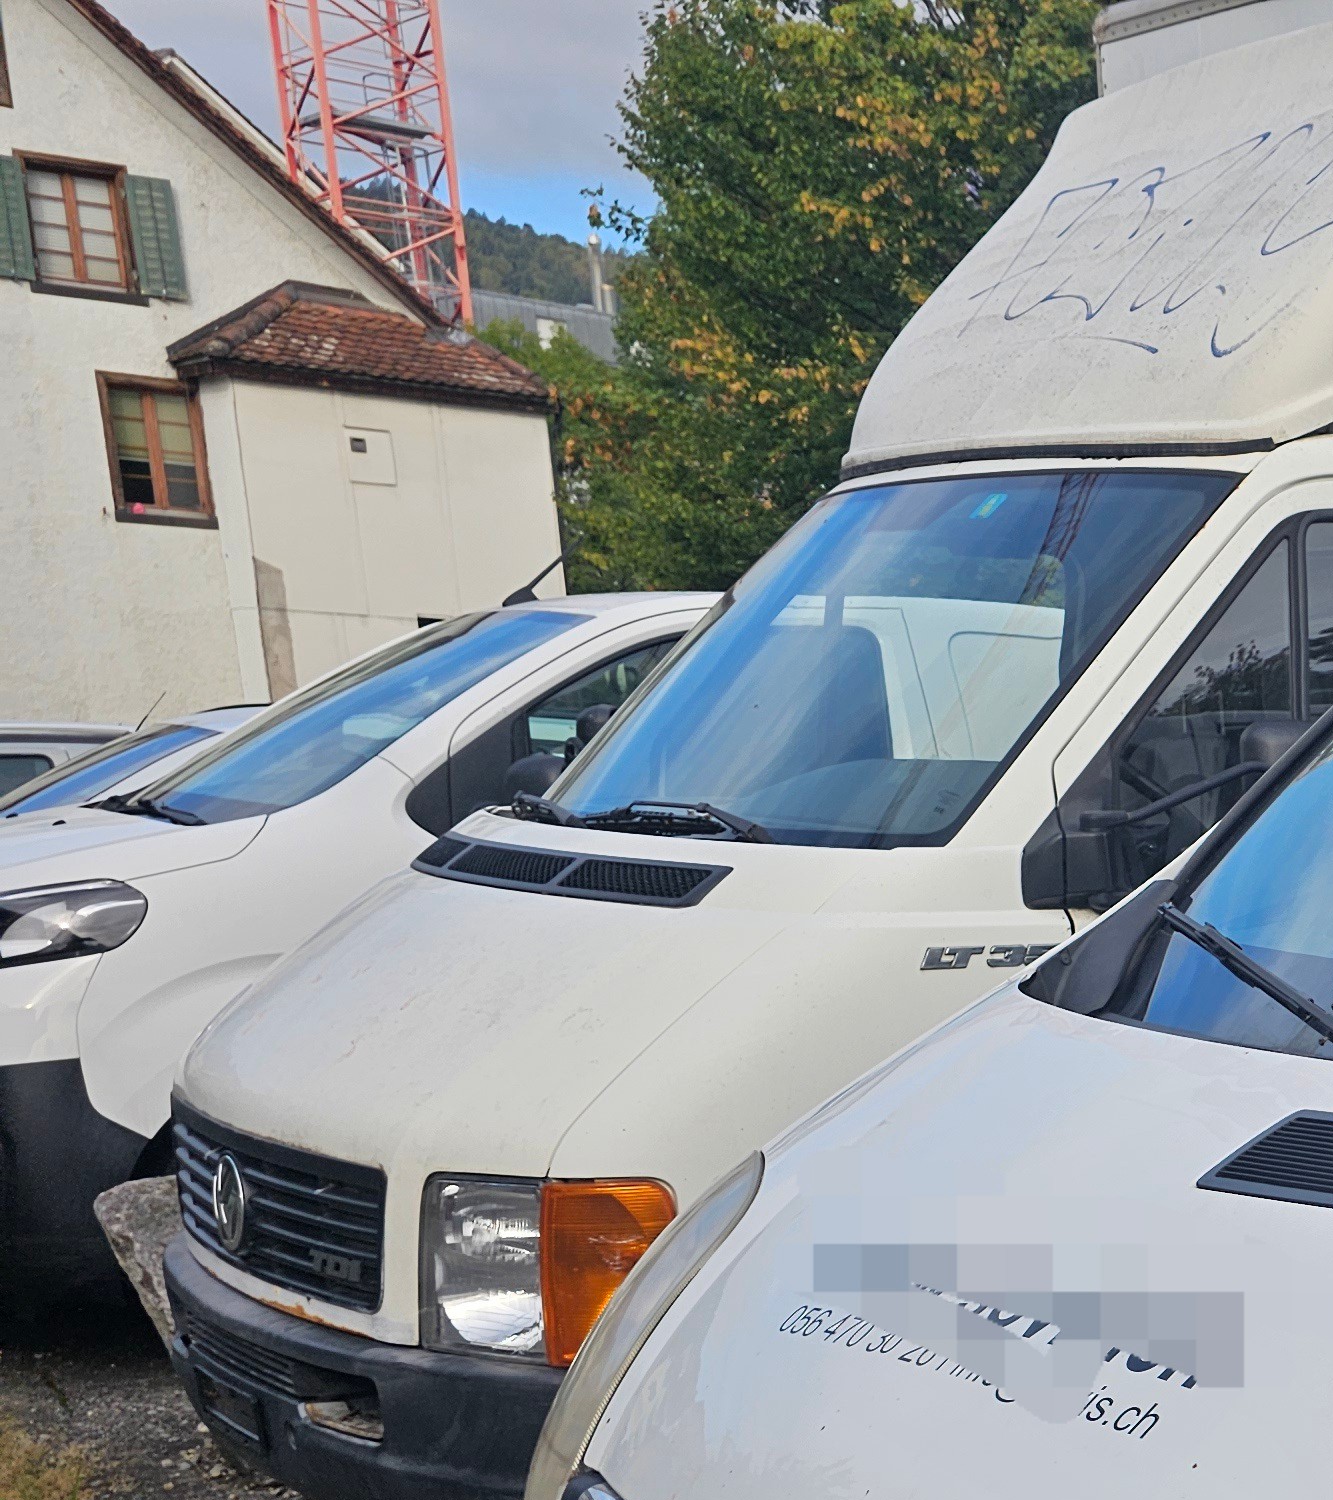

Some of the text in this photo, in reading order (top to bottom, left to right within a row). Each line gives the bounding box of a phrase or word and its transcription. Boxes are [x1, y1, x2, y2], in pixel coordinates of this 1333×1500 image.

[920, 945, 986, 971] LT
[308, 1248, 362, 1283] TDI
[779, 1304, 833, 1337] 056
[823, 1313, 876, 1348] 470
